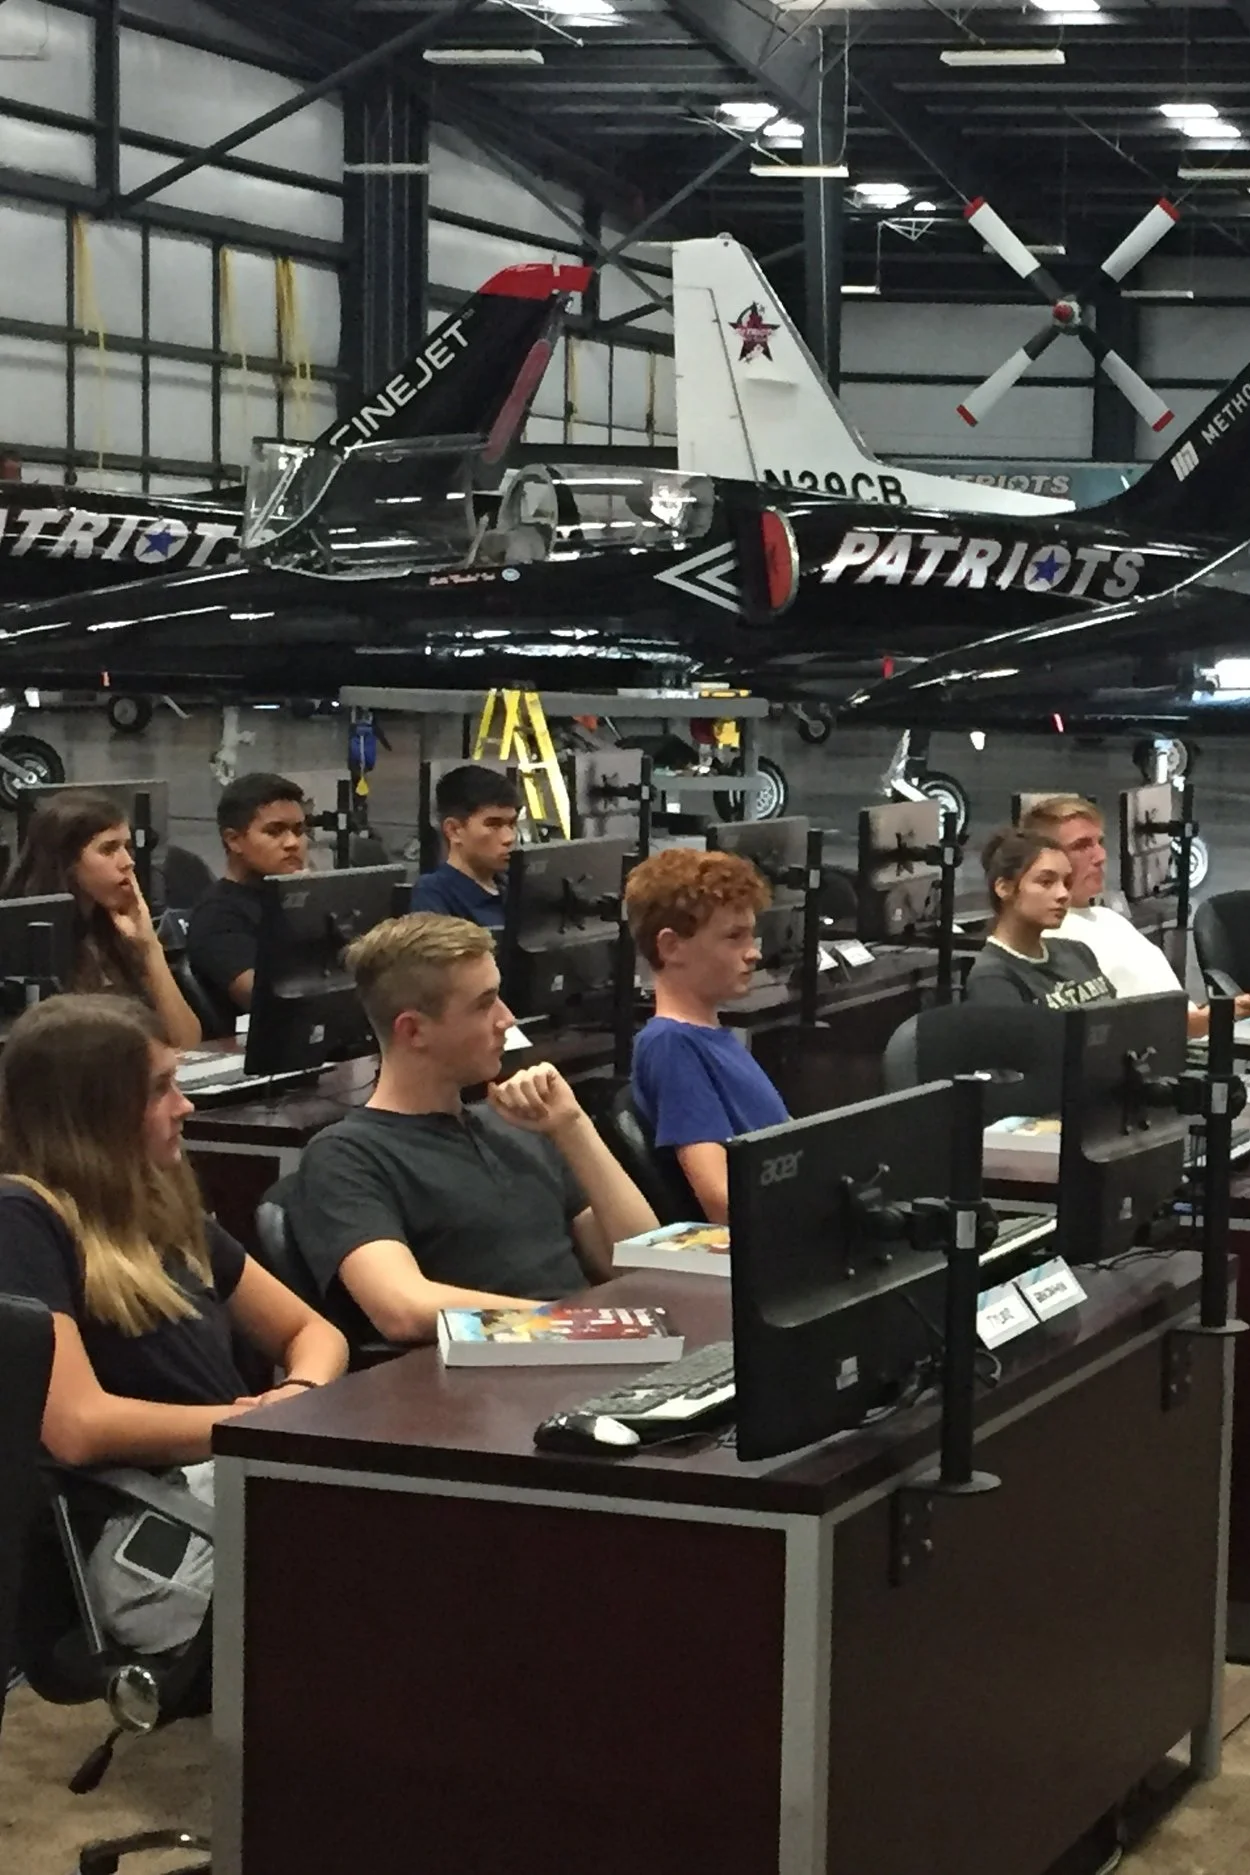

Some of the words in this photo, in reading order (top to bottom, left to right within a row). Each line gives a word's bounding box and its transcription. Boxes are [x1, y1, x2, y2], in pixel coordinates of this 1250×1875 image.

[329, 319, 469, 448] CINEJET
[0, 507, 244, 568] TRIOT
[819, 531, 1146, 598] PATRIOTS
[760, 1149, 803, 1186] acer
